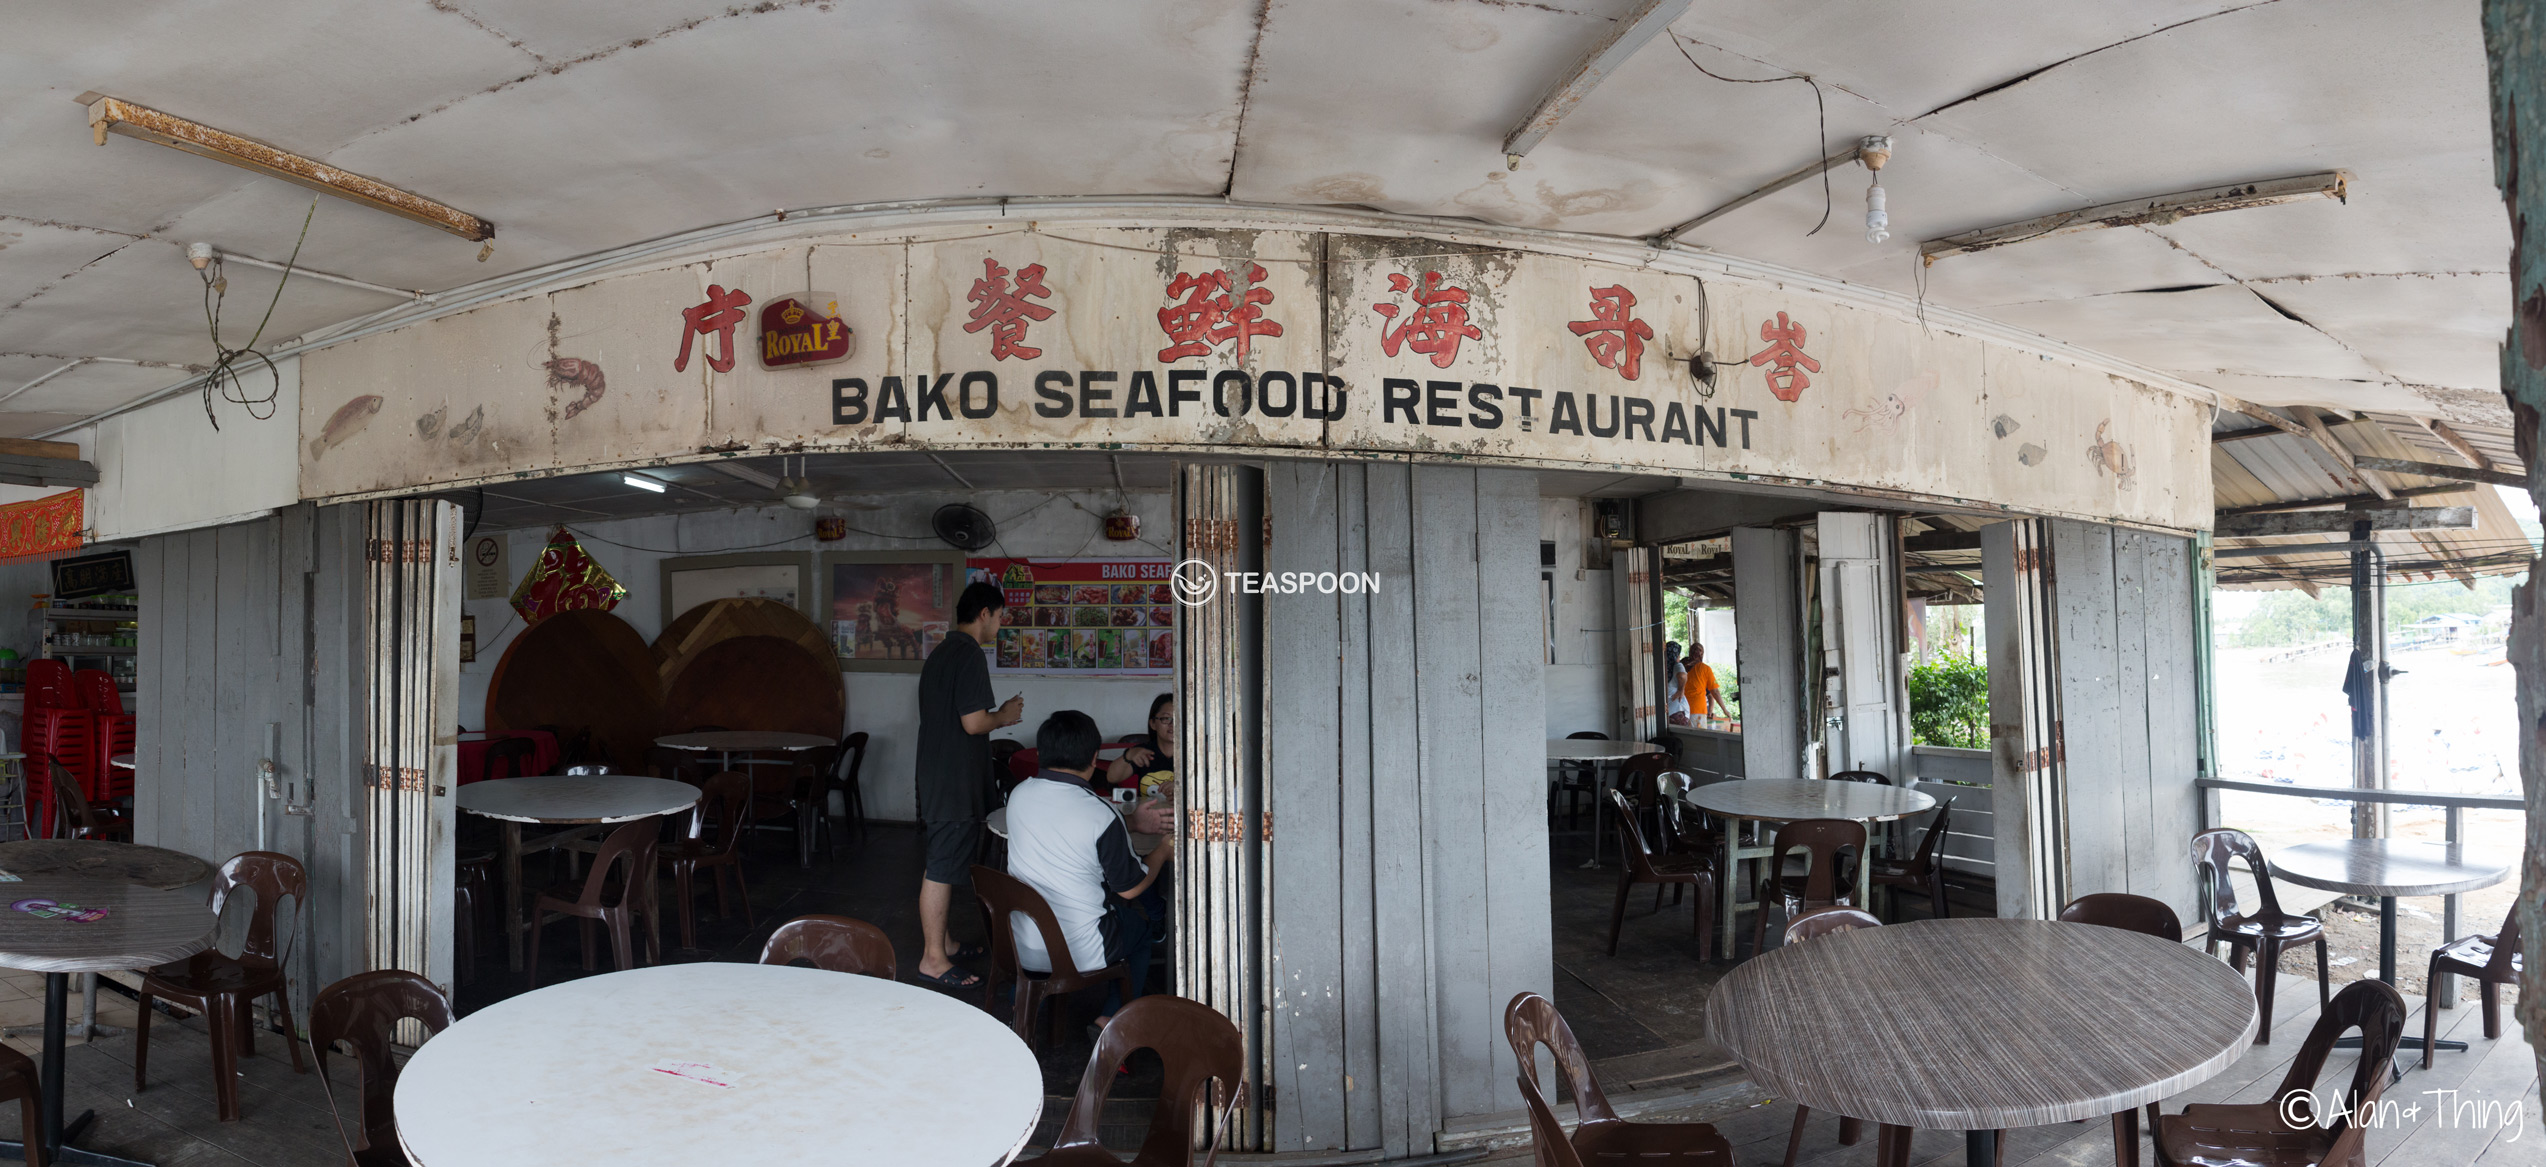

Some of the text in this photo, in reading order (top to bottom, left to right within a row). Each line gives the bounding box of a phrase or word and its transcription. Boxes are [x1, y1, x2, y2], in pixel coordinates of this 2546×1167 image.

[766, 323, 829, 360] ROYAL
[831, 369, 1759, 450] BAKO SEAFOOD RESTAURANT
[1107, 526, 1132, 537] ROYAL
[1667, 544, 1691, 555] ROYAL
[1102, 564, 1136, 579] BAKO
